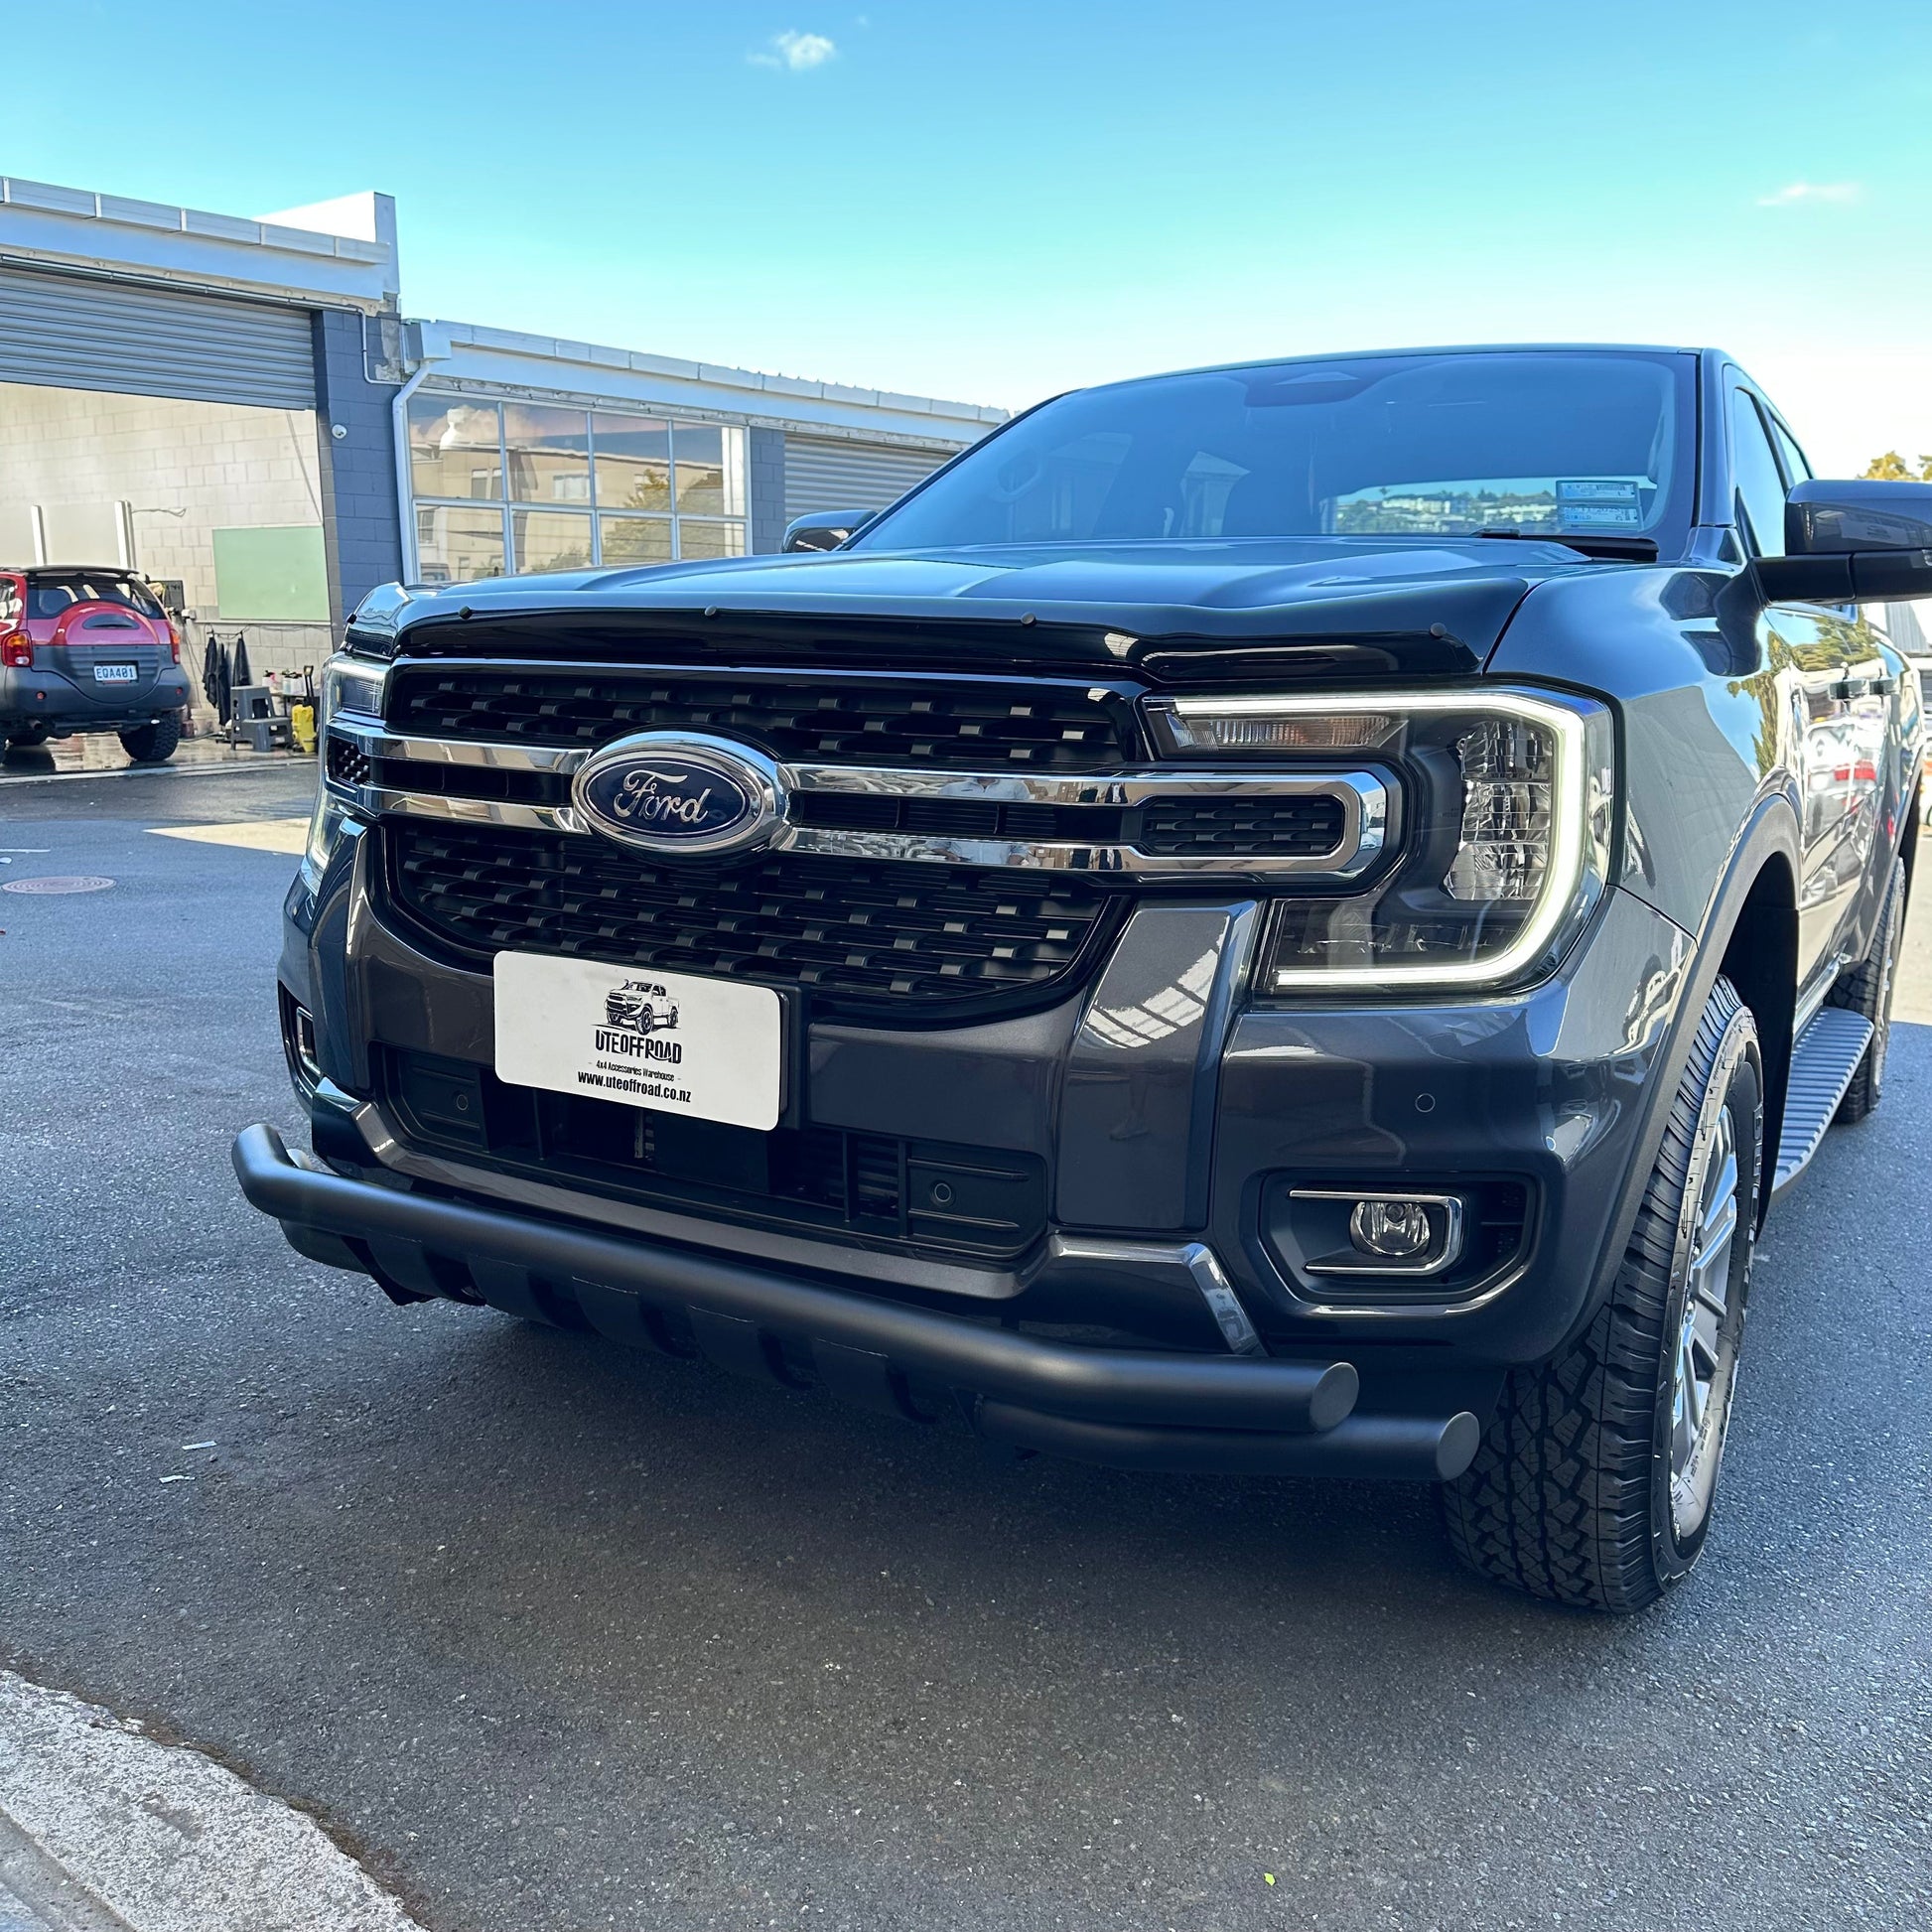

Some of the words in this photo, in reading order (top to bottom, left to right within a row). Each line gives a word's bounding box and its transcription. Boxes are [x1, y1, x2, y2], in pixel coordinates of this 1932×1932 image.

[613, 769, 712, 823] Ford
[596, 1029, 682, 1064] UTEOFFROAD
[578, 1071, 691, 1103] www.uteoffroad.co.nz
[596, 1059, 607, 1070] 4x4
[608, 1062, 641, 1076] Accessories
[642, 1067, 675, 1082] Warehouse
